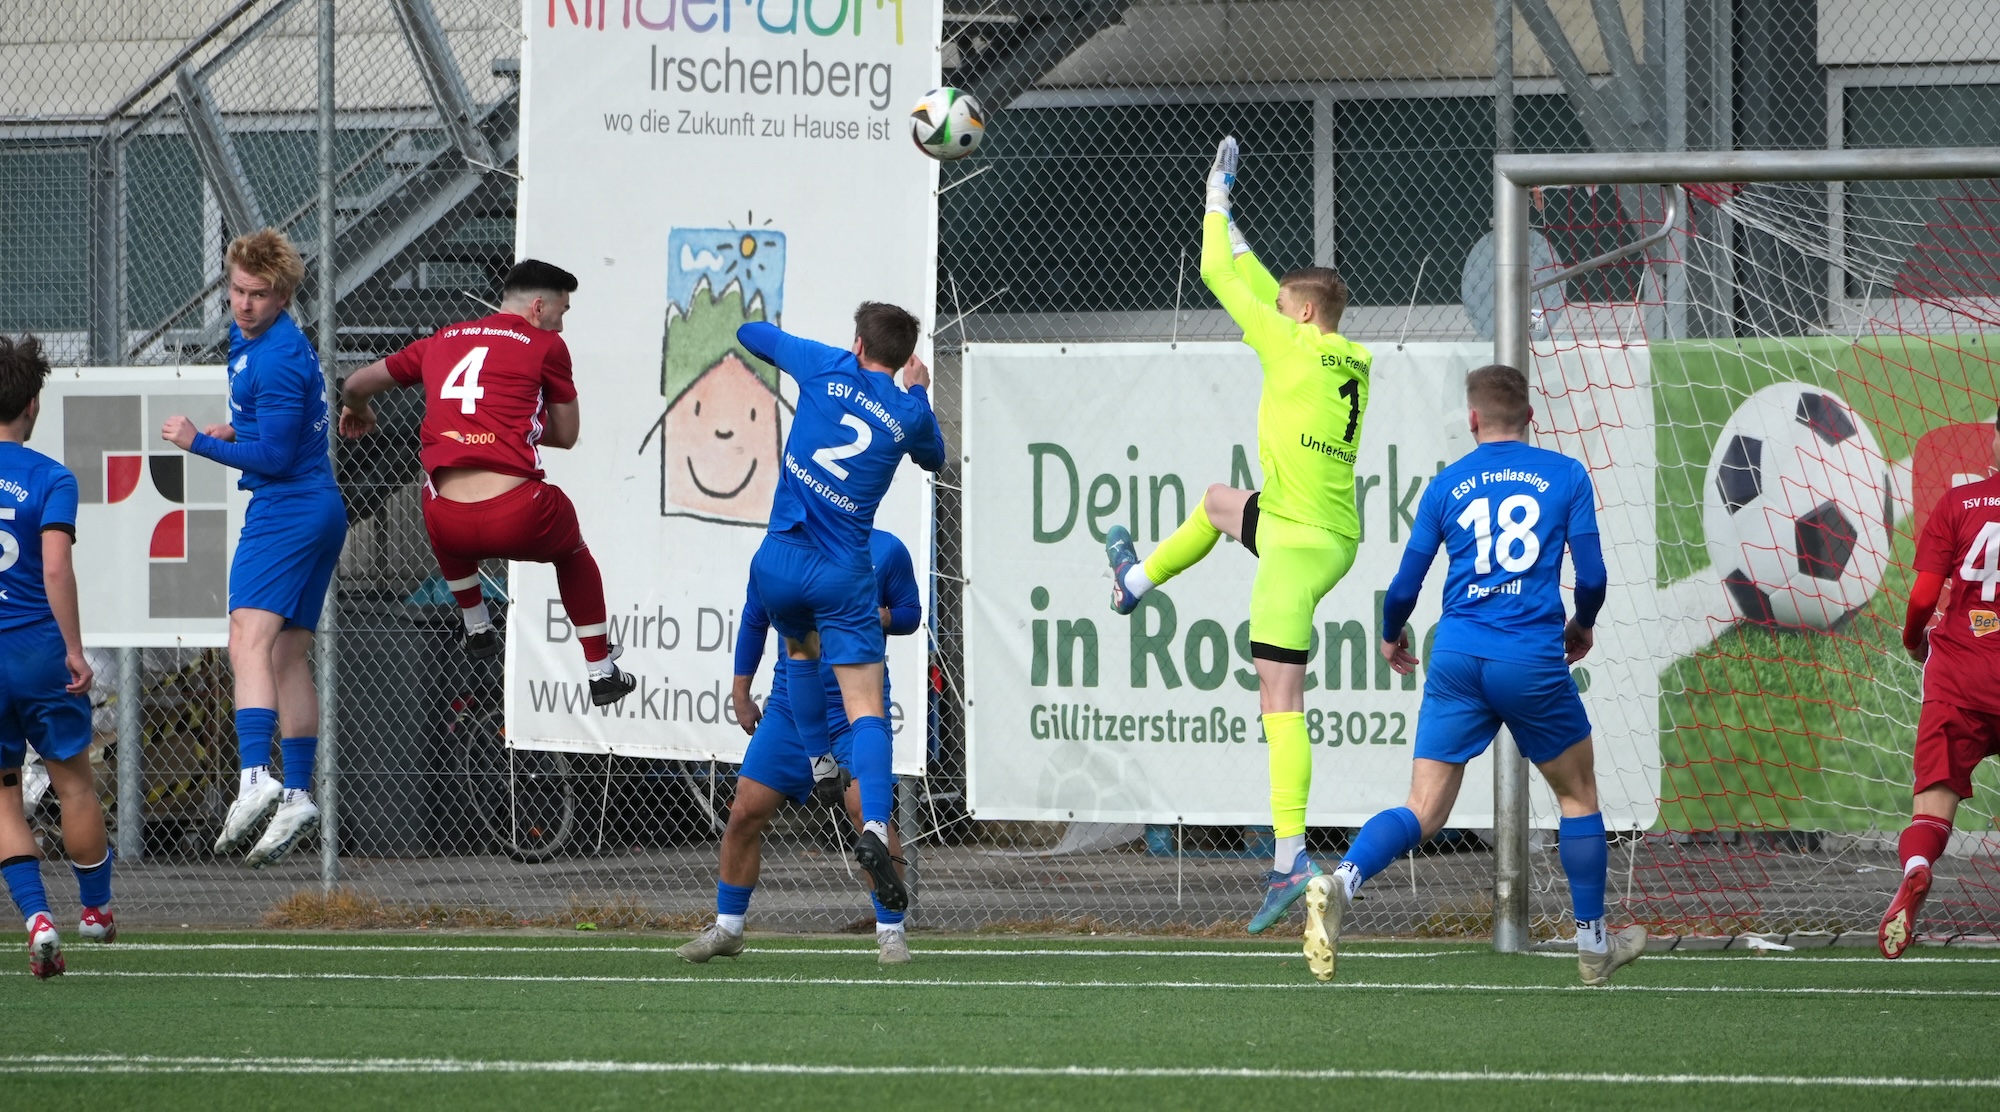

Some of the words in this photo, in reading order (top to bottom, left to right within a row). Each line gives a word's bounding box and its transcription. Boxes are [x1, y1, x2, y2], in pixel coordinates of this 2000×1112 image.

[650, 44, 893, 111] Irschenberg
[604, 113, 633, 132] wo
[640, 109, 670, 133] die
[677, 110, 756, 137] Zukunft
[761, 118, 786, 137] zu
[794, 114, 860, 140] Hause
[866, 117, 891, 141] ist
[461, 327, 481, 336] 1860
[482, 327, 531, 344] Rosenheim
[1321, 354, 1342, 367] ESV
[440, 346, 489, 414] 4
[465, 432, 496, 445] 3000
[827, 382, 853, 399] ESV
[854, 391, 905, 443] Freilassing
[1338, 378, 1361, 444] 1
[811, 413, 873, 482] 2
[1028, 442, 1186, 544] Dein
[1451, 476, 1477, 500] ESV
[1481, 468, 1550, 493] Freilassing
[1962, 498, 1981, 510] TSV
[1456, 494, 1541, 575] 18
[1959, 521, 2000, 603] 4
[546, 598, 681, 651] Bwirb
[1030, 586, 1099, 688] in
[1030, 704, 1247, 745] Gillitzerstraße
[1309, 710, 1408, 747] 83022
